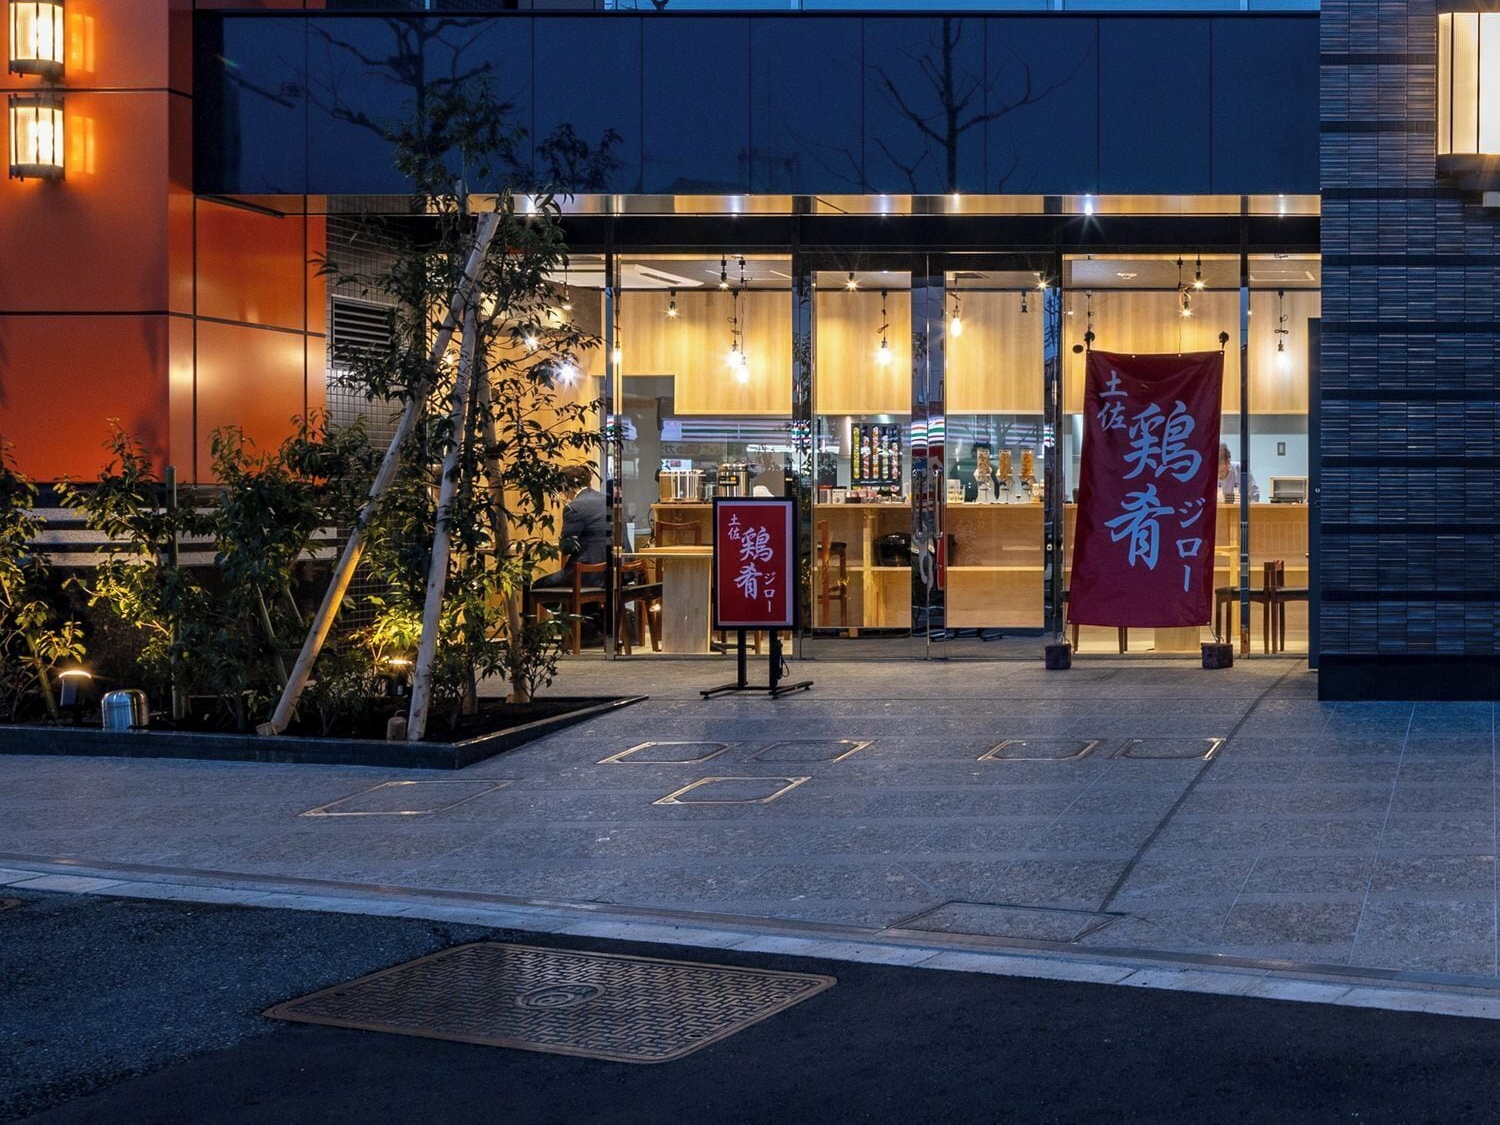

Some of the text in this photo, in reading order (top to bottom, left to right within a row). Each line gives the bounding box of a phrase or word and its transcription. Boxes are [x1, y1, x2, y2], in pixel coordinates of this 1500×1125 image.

[1097, 370, 1128, 432] 土佐
[1104, 400, 1203, 571] 鶏肴
[728, 514, 741, 540] 土佐
[1176, 498, 1206, 593] ジロー
[734, 527, 773, 599] 鶏肴
[764, 572, 776, 612] ジロー
